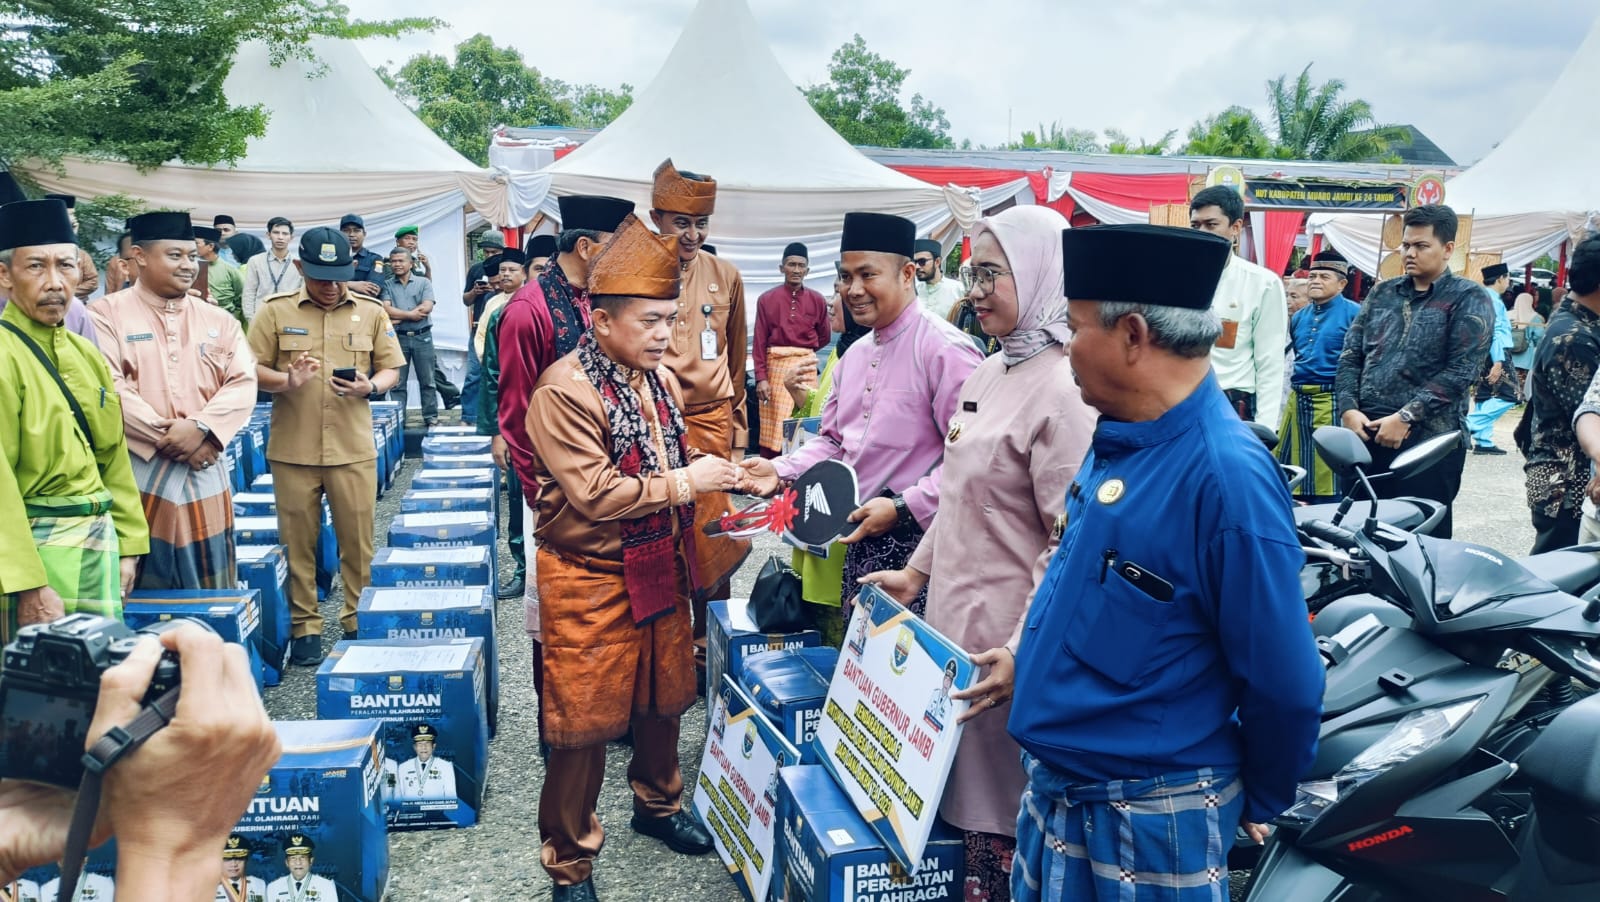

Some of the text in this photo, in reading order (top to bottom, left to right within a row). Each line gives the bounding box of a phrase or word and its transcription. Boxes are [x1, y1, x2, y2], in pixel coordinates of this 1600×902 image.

[804, 484, 812, 523] HONDA
[1465, 547, 1503, 566] HONDA
[387, 627, 466, 640] BANTUAN
[749, 641, 804, 653] BANTUAN
[350, 693, 441, 708] BANTUAN
[843, 658, 875, 699] BANTUAN
[871, 686, 911, 736] GUBERNUR
[908, 724, 935, 762] JAMBI
[709, 740, 732, 775] BANTUAN
[729, 766, 756, 809] GUBERNUR
[754, 800, 771, 830] JAMBI
[254, 814, 299, 822] OLAHRAGA
[1348, 825, 1414, 852] HONDA
[784, 817, 814, 885] BANTUAN
[857, 870, 954, 893] PERALATAN
